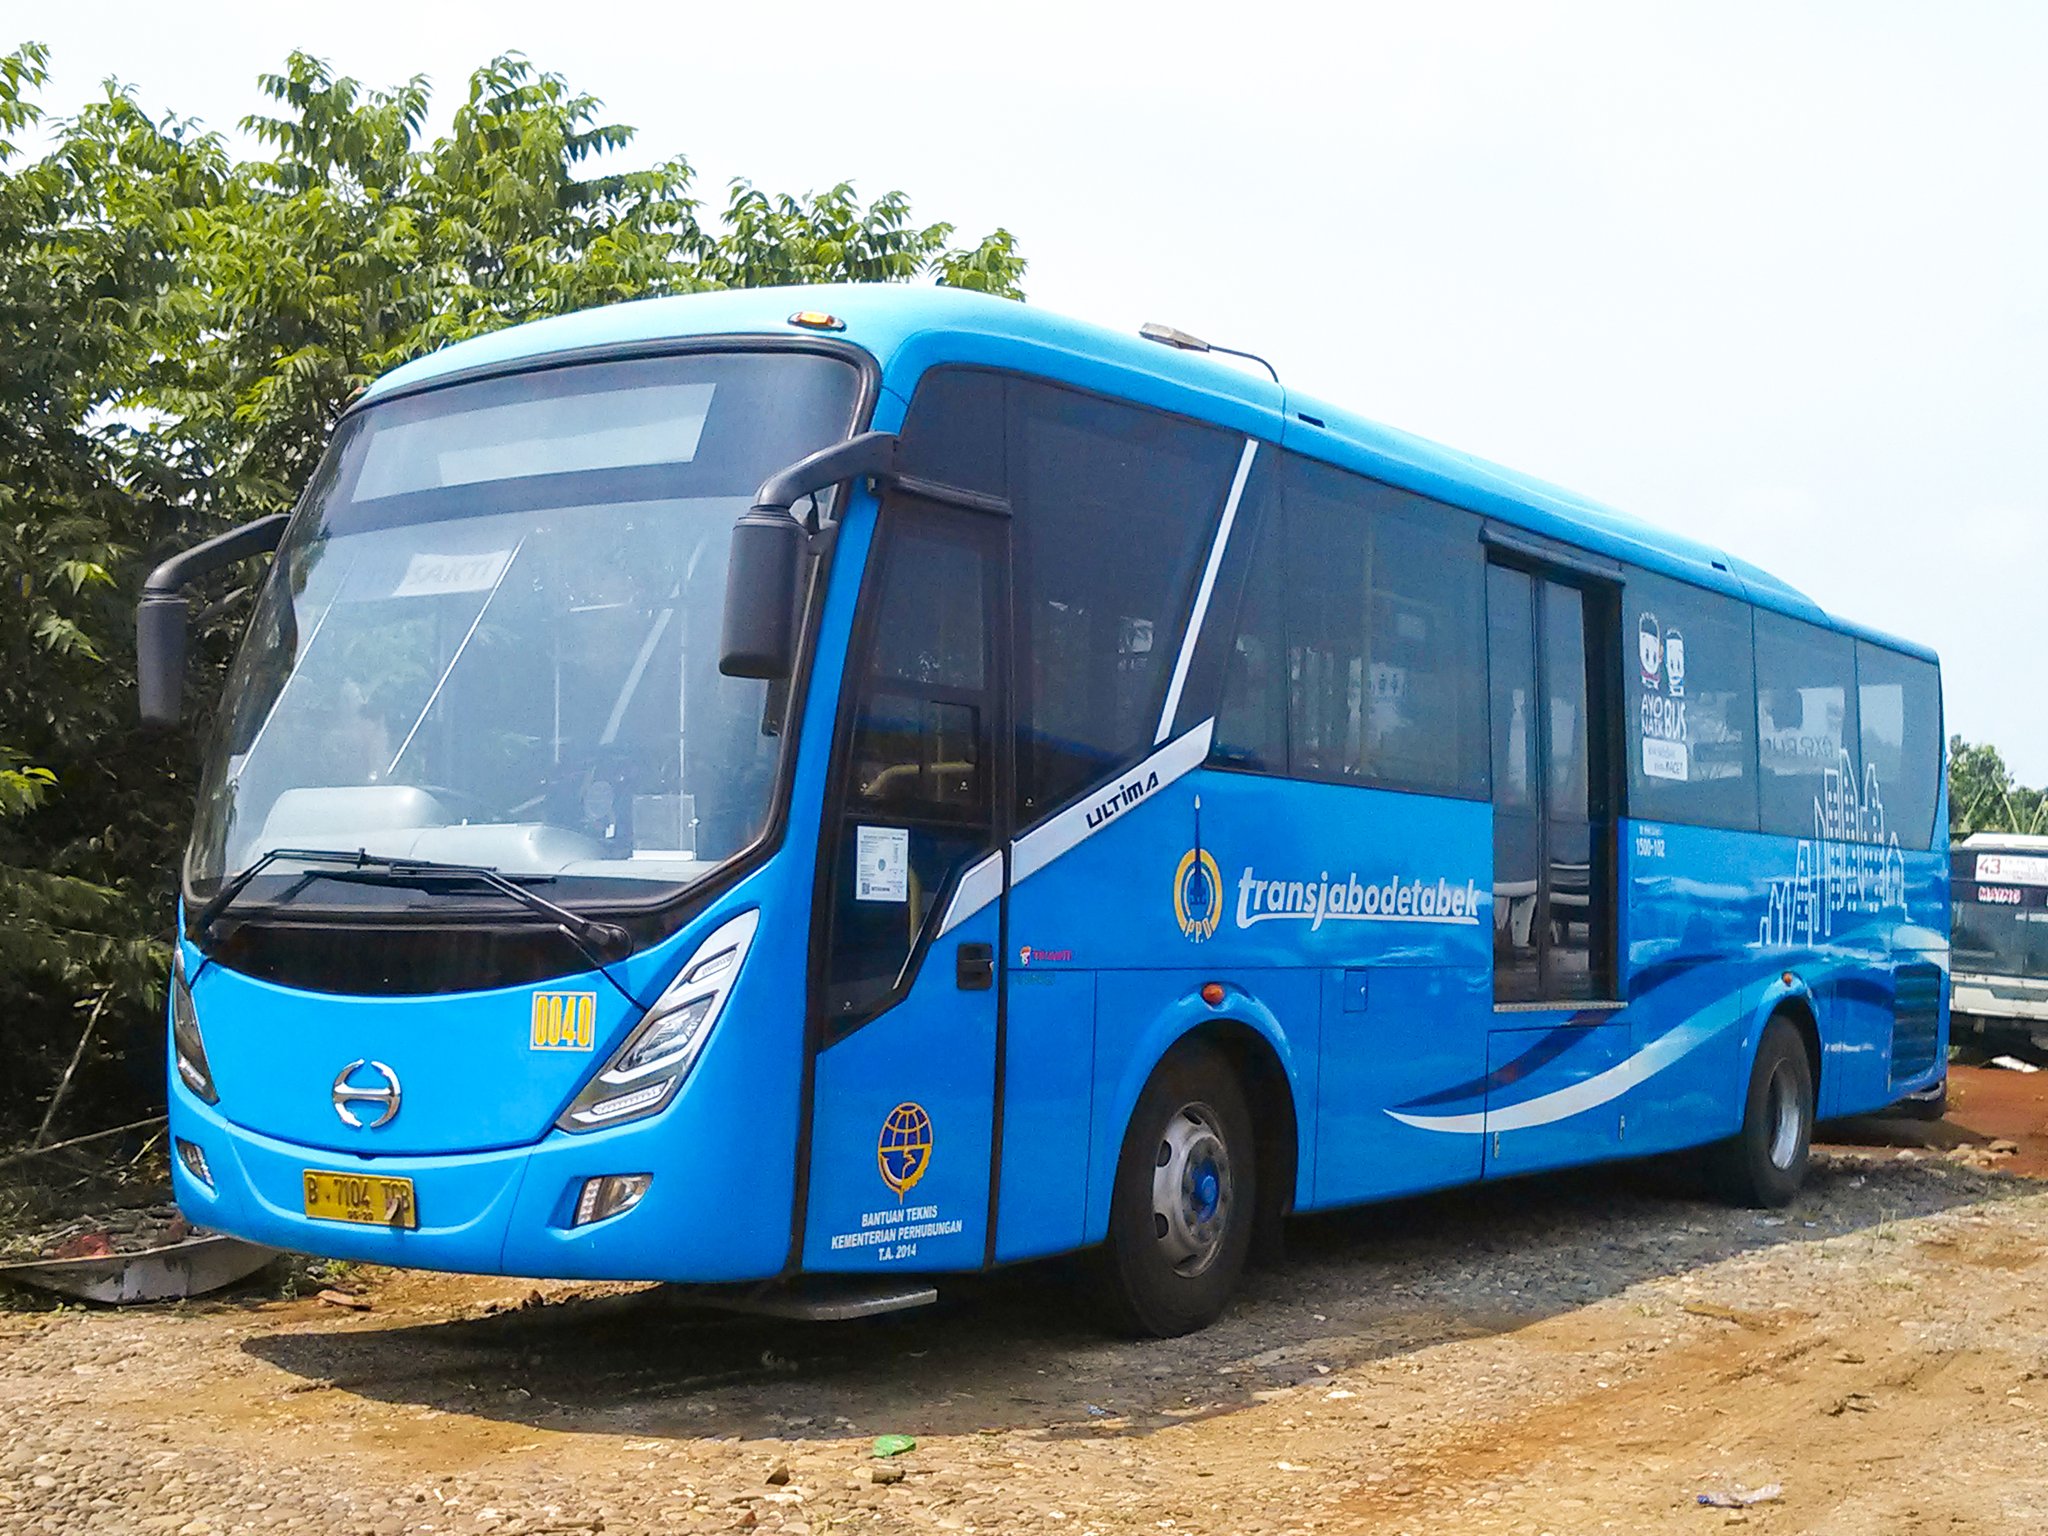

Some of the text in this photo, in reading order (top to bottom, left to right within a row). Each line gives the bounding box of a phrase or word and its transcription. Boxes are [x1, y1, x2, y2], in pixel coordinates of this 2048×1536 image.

[1641, 693, 1663, 719] AYO
[1664, 698, 1687, 741] BUS
[1979, 858, 2001, 875] 43
[1236, 866, 1479, 931] transjabodetabek
[535, 995, 592, 1047] 0040
[306, 1175, 318, 1204] B
[333, 1177, 371, 1207] 7104
[861, 1205, 938, 1228] BANTUAN TEKNIS
[831, 1219, 963, 1250] KEMENTERIAN PERHUBUNGAN
[895, 1243, 917, 1259] 2014
